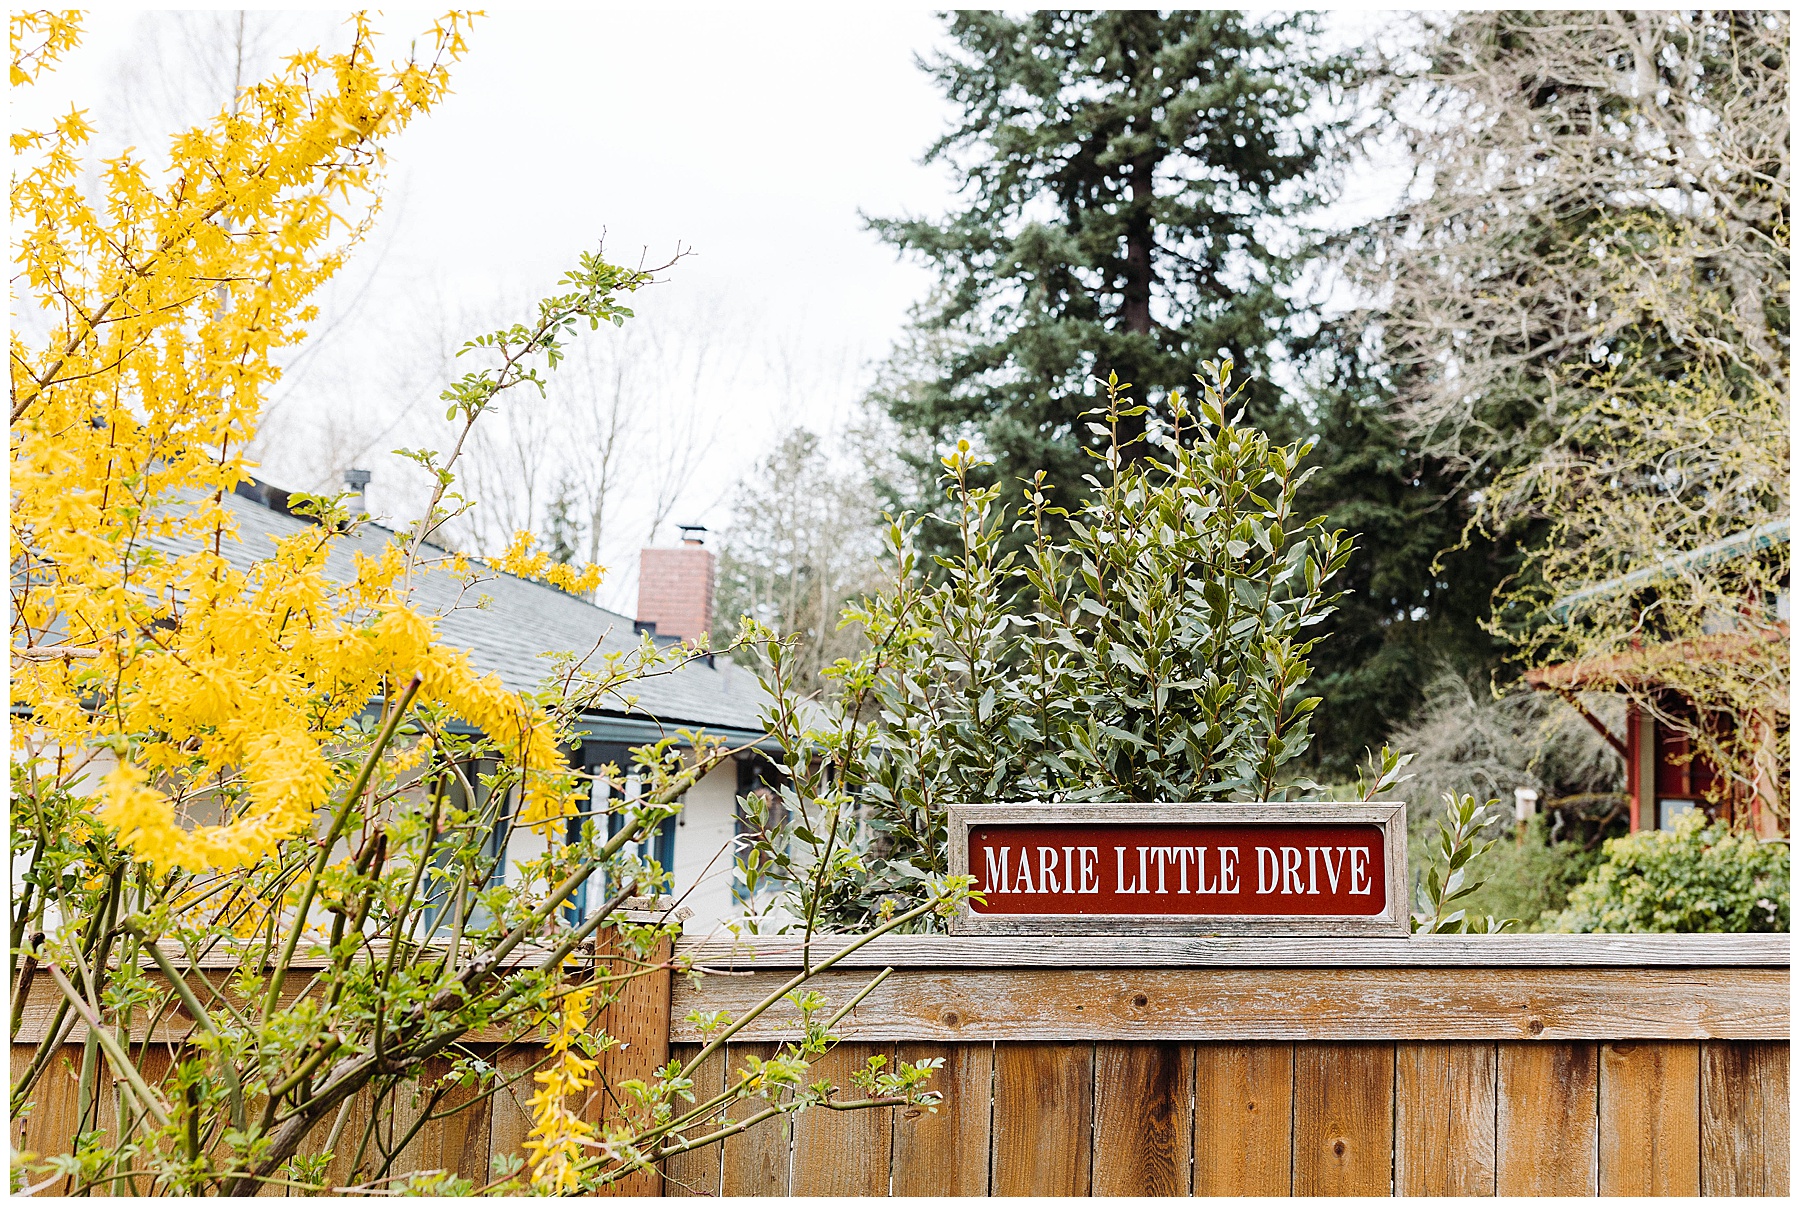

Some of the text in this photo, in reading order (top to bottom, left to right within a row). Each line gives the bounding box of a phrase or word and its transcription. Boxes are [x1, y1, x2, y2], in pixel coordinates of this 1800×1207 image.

[983, 846, 1372, 895] MARIE LITTLE DRIVE
